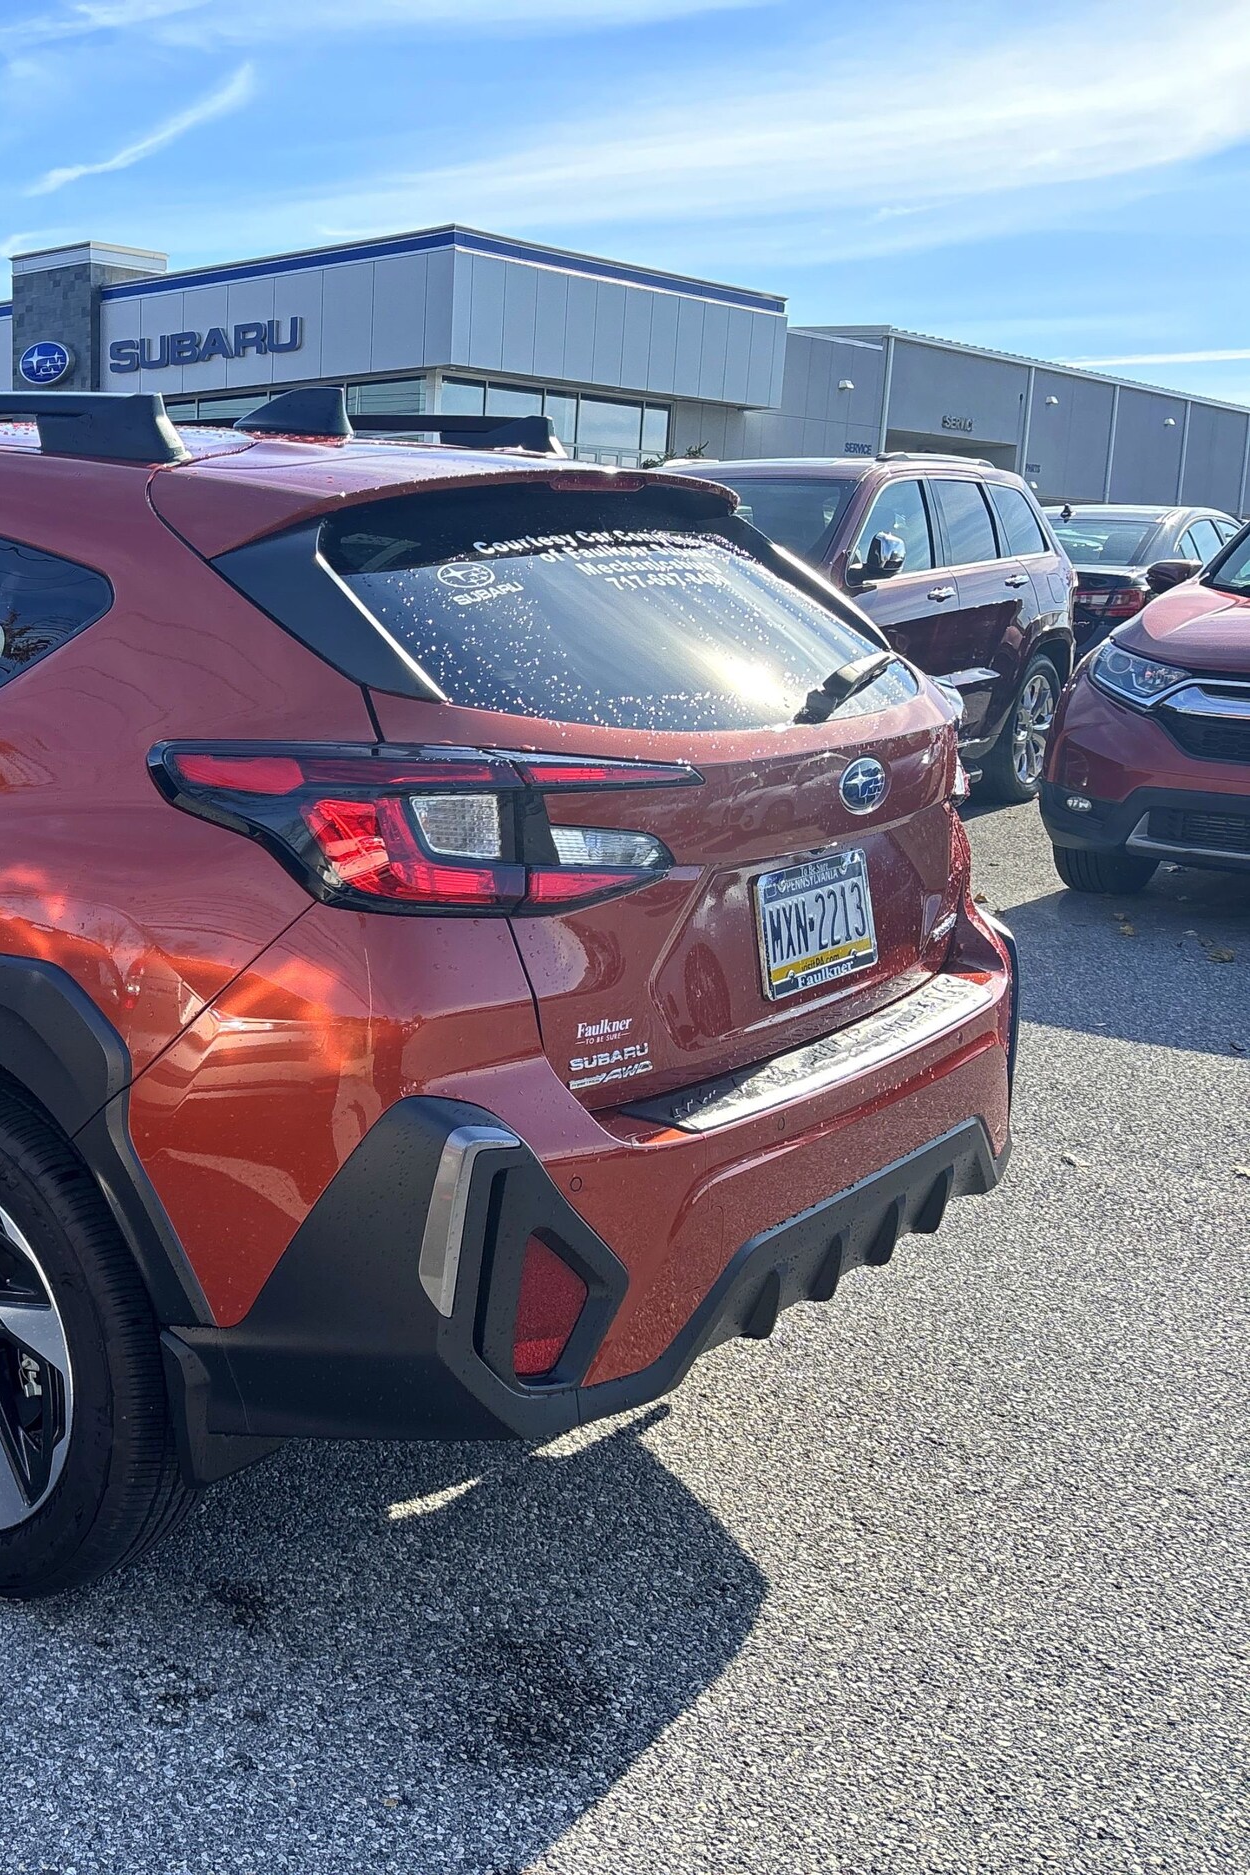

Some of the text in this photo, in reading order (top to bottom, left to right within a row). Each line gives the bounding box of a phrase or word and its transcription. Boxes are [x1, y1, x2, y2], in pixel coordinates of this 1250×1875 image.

[109, 316, 302, 373] SUBARU
[942, 415, 974, 432] SERVIC
[845, 442, 872, 456] SERVICE
[473, 534, 578, 555] Courtesy
[575, 530, 614, 543] Car
[539, 543, 714, 563] of Faulkner Subaru
[575, 557, 723, 576] Mechanicsburg
[453, 581, 525, 606] SUBARU
[785, 868, 839, 893] PENNSYLVANIA
[800, 867, 808, 877] To
[797, 960, 854, 989] Faulkner
[576, 1018, 633, 1039] Faulkner
[606, 1032, 622, 1042] SURE
[569, 1042, 649, 1072] SUBARU
[601, 1060, 654, 1083] AWD
